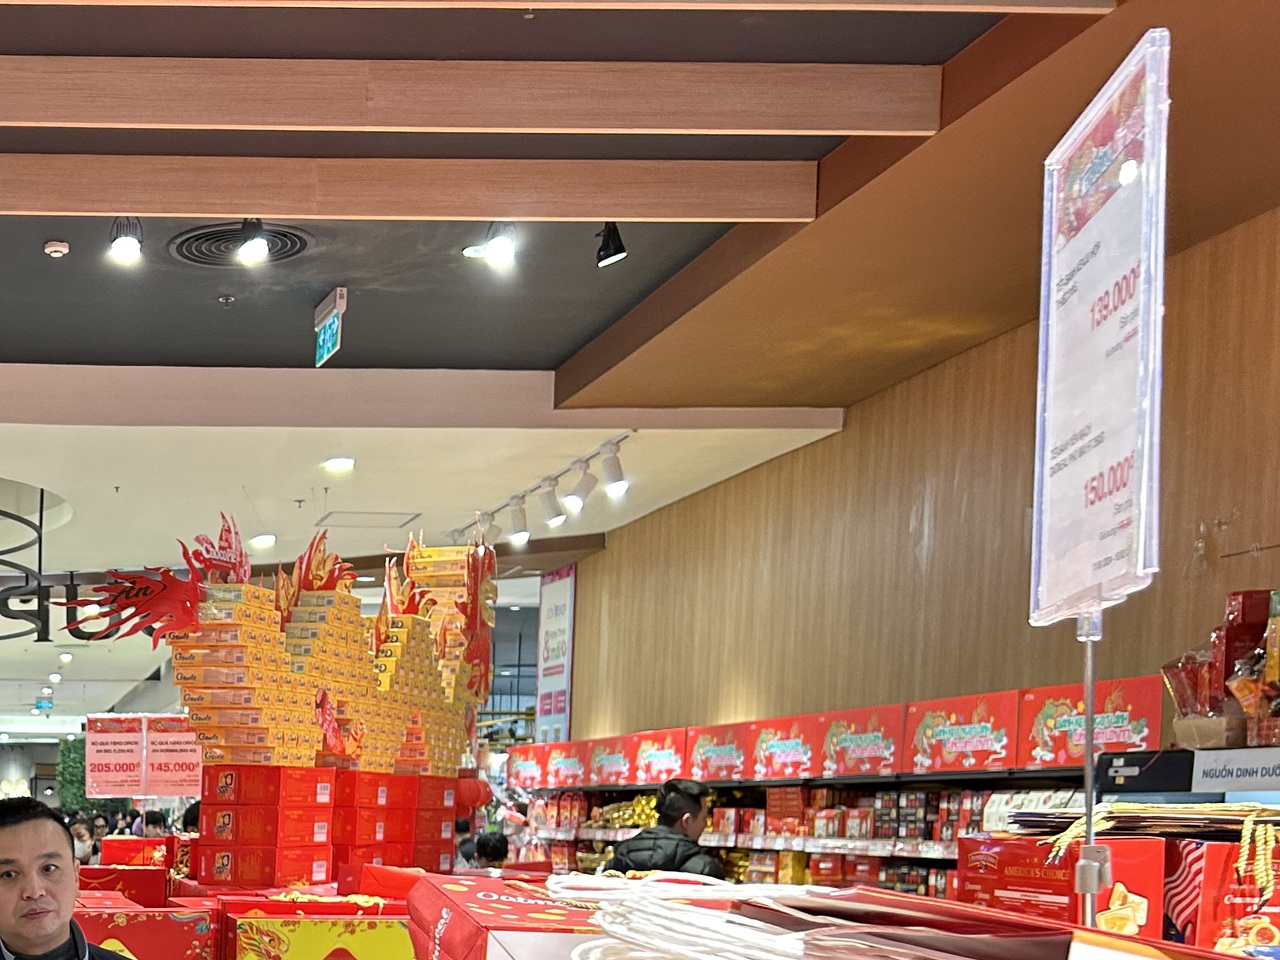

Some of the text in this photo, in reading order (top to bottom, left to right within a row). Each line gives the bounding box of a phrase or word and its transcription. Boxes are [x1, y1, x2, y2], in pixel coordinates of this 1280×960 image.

[90, 762, 140, 773] 205.000đ
[149, 762, 199, 772] 145.000đ
[1236, 767, 1258, 778] DINH
[1004, 866, 1071, 880] AMERICA'S CHOICE
